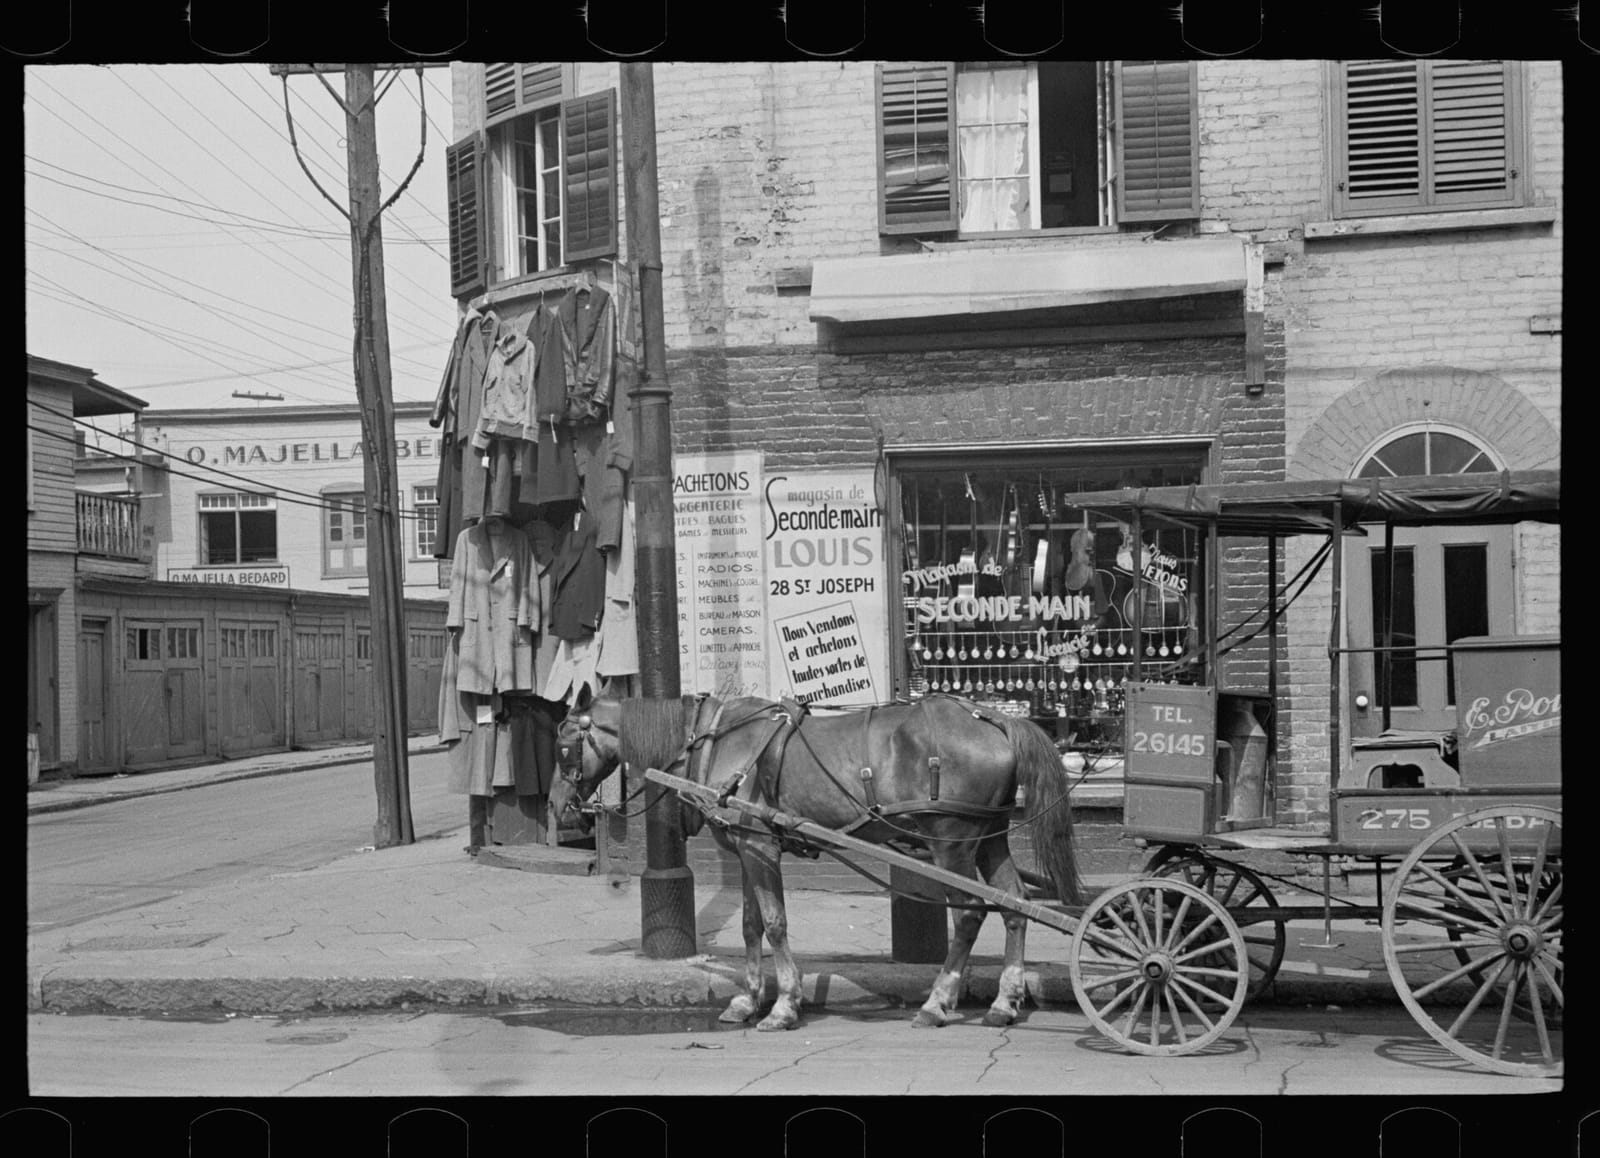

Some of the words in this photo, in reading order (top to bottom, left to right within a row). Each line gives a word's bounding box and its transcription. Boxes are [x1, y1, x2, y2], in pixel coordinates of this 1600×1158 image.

[673, 471, 750, 493] ACHETONS
[787, 486, 843, 507] magasin
[849, 484, 865, 500] de
[708, 514, 746, 525] BAGUES
[765, 476, 881, 541] Seconde-main
[774, 536, 873, 569] LOUIS
[239, 571, 287, 584] BEDARD
[981, 556, 1002, 577] de
[1142, 564, 1189, 592] ETONS
[770, 580, 790, 596] 28
[794, 579, 811, 595] ST
[816, 577, 875, 595] JOSEPH
[698, 594, 739, 605] MEUBLES
[917, 595, 1091, 624] SECONDE-MAIN
[699, 611, 725, 621] BUREAU
[732, 610, 761, 619] MAISON
[781, 625, 808, 643] Nous
[806, 614, 855, 636] Vendons
[788, 645, 800, 662] et
[805, 635, 857, 658] achetons
[792, 664, 824, 684] toutes
[824, 657, 852, 676] sortes
[854, 653, 866, 669] de
[794, 678, 871, 704] marchandises
[1152, 705, 1193, 724] TEL.
[1133, 732, 1205, 756] 26145
[1361, 809, 1431, 830] 275
